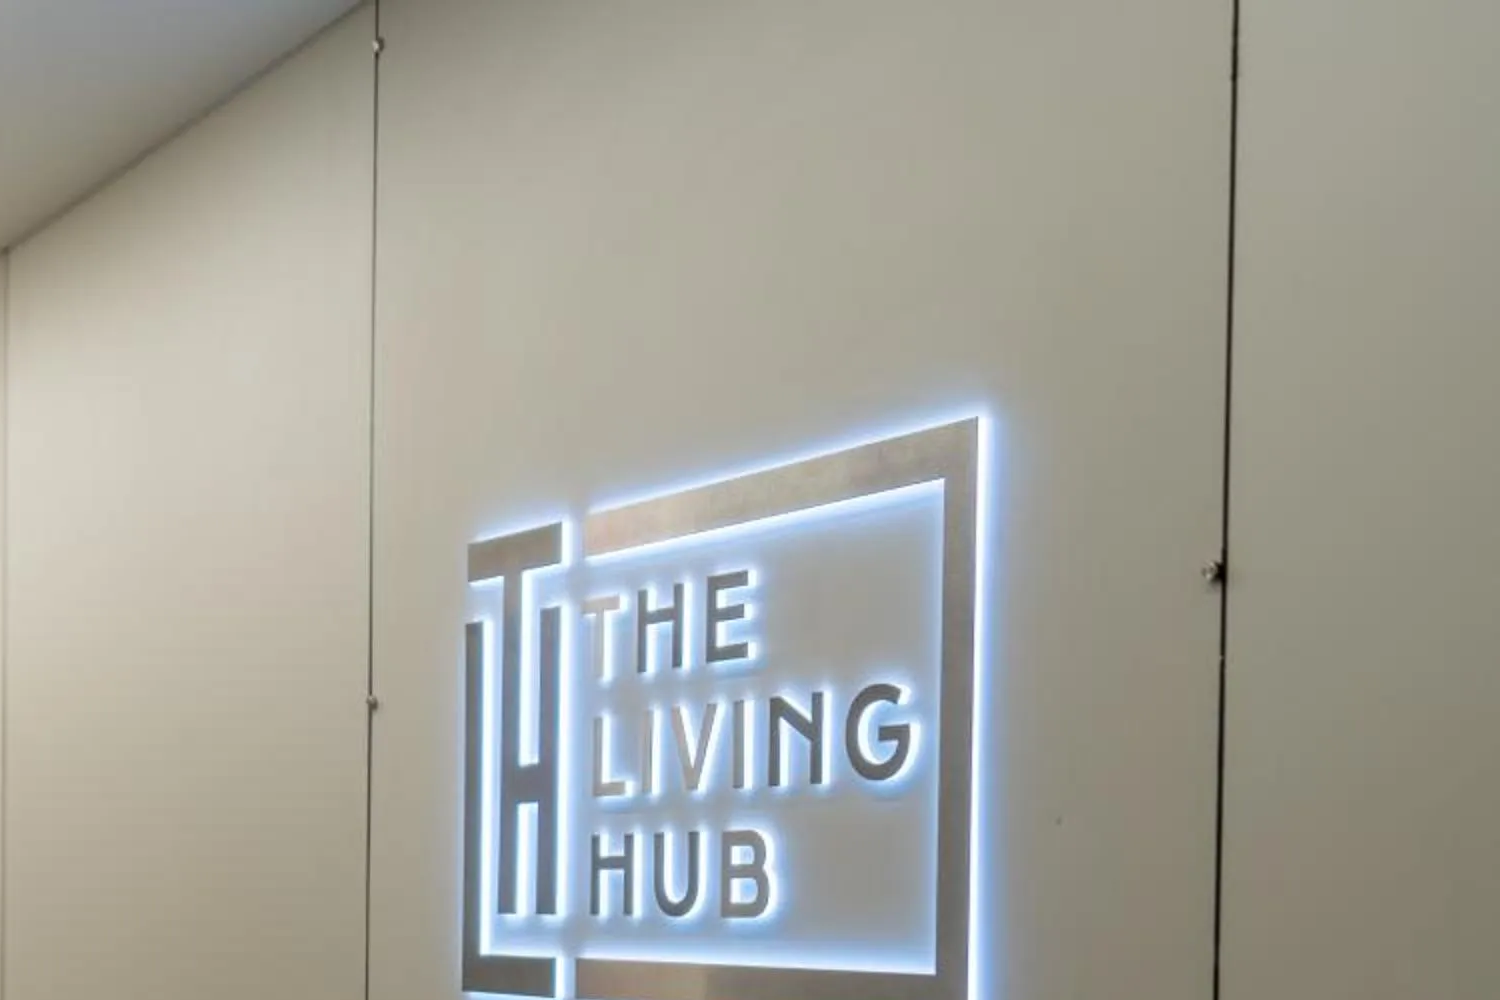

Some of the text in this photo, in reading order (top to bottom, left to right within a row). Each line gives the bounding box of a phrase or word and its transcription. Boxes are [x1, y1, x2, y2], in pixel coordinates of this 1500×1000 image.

[581, 569, 754, 681] THE
[592, 682, 916, 798] LIVING
[589, 828, 773, 919] HUB
